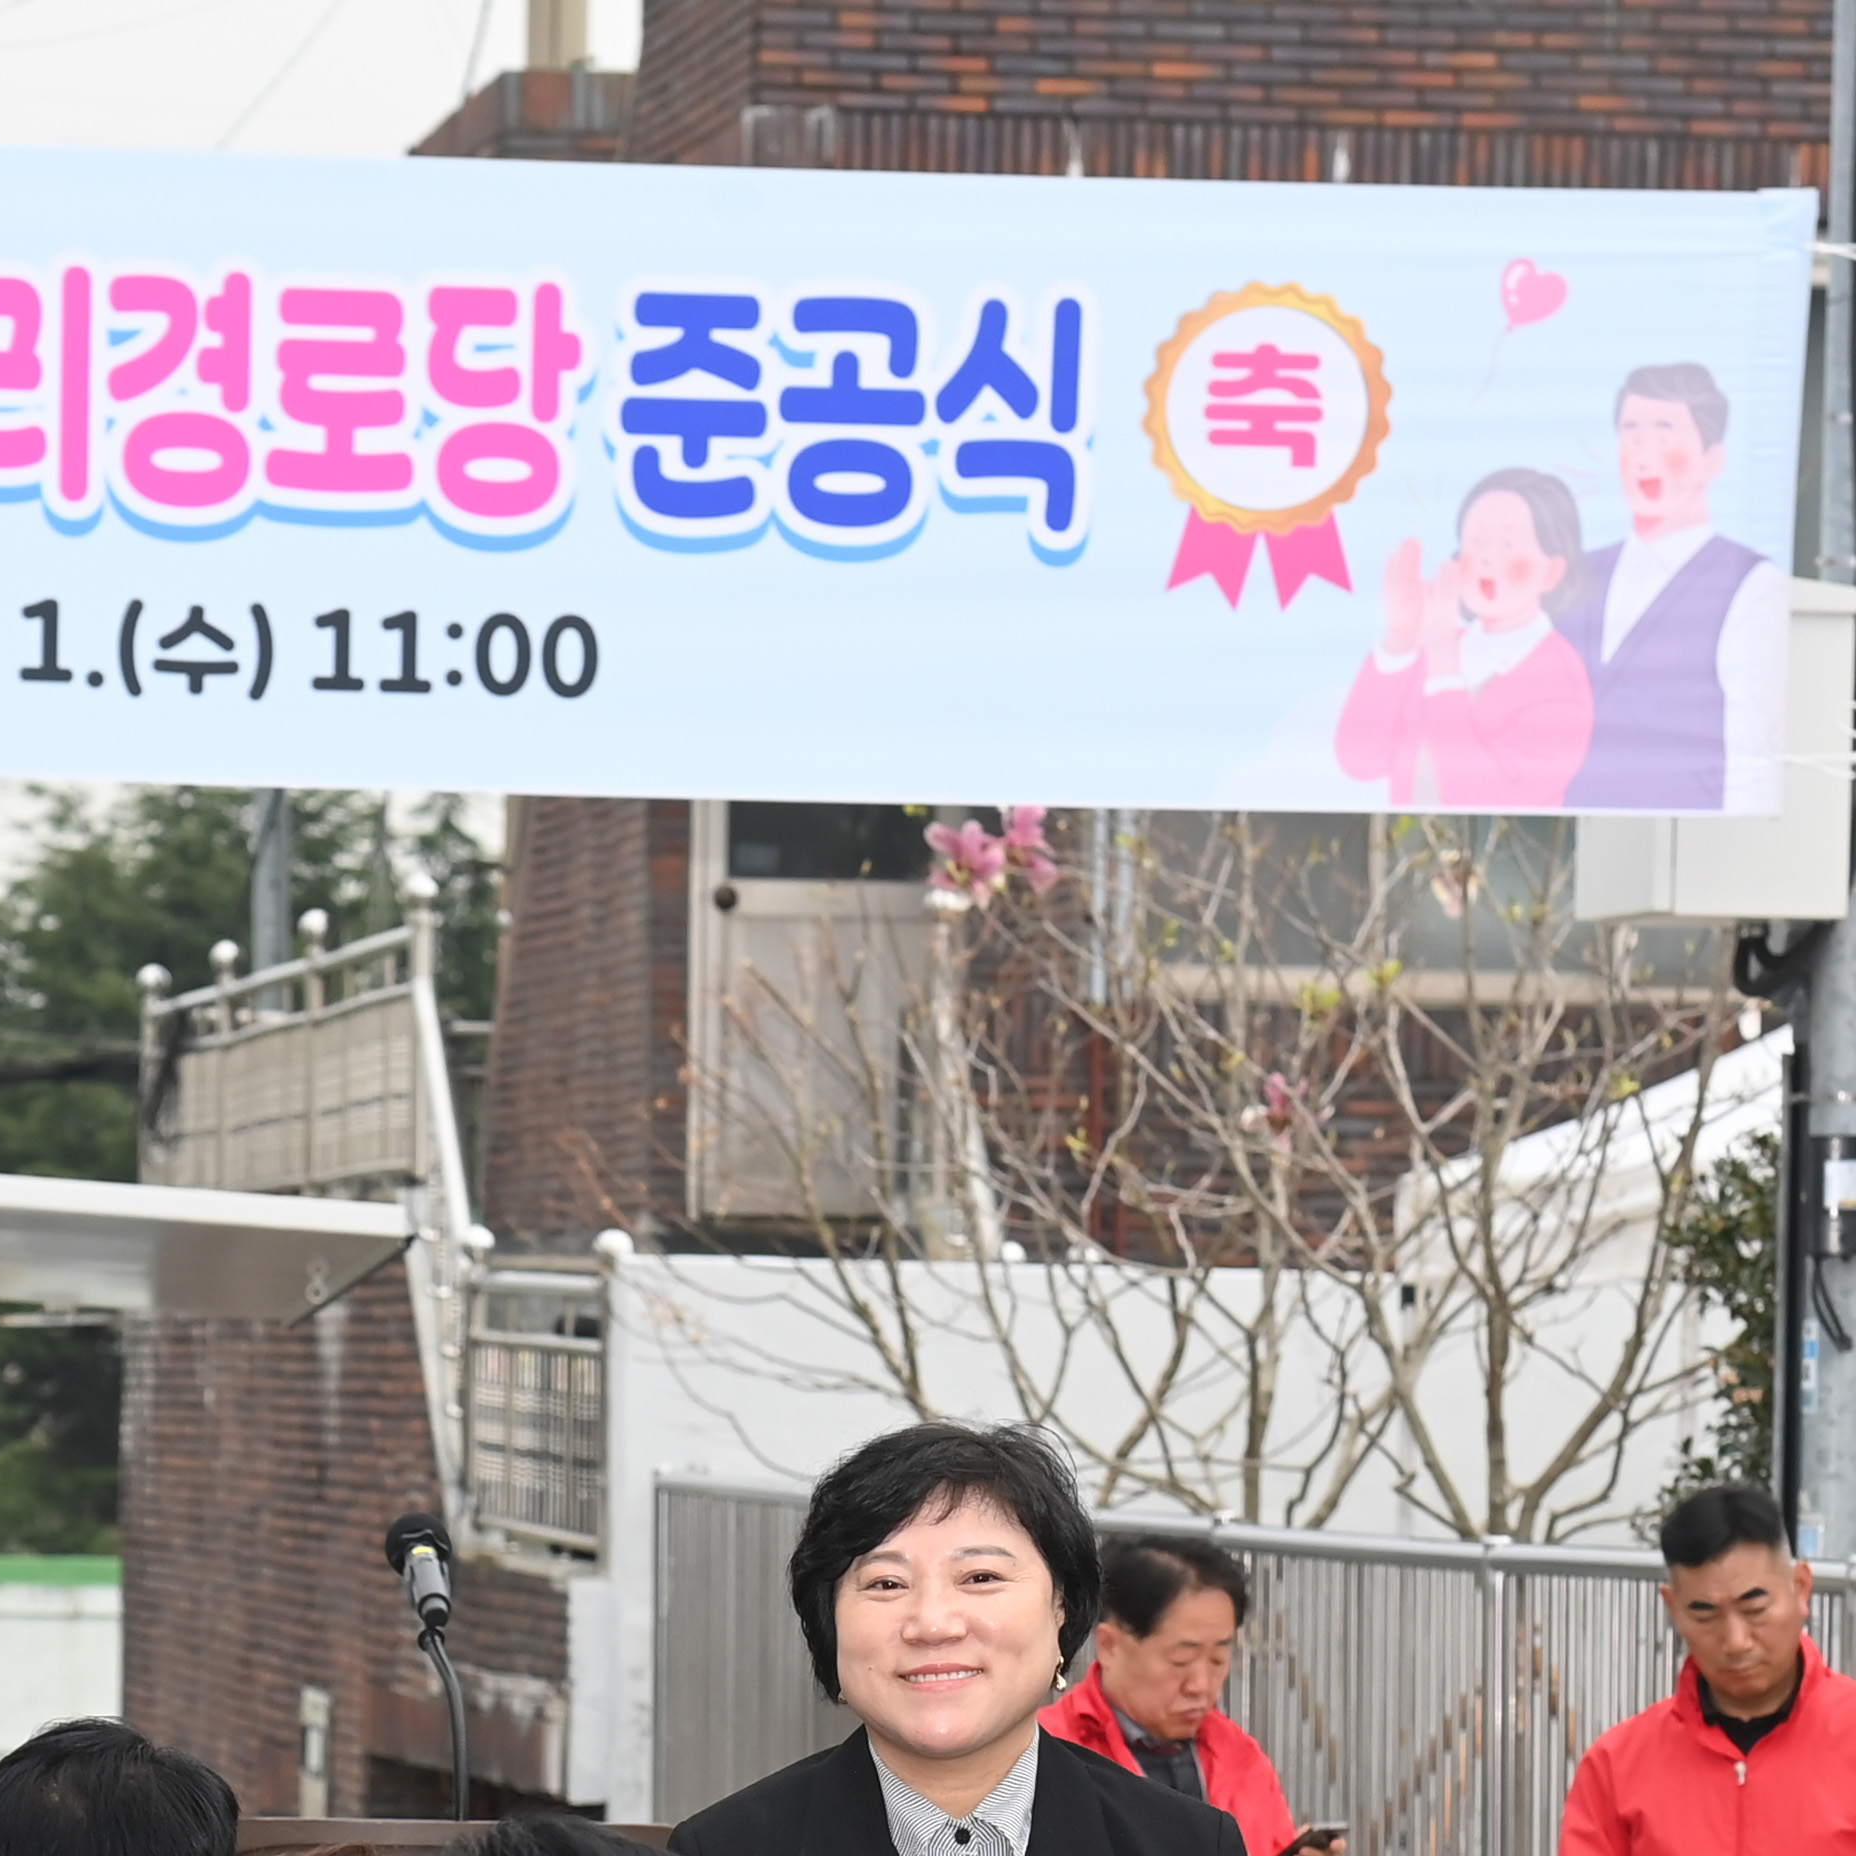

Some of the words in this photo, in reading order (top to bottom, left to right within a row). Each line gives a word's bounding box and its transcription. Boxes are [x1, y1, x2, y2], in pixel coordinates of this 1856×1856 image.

[619, 291, 1083, 534] 준공식
[1204, 342, 1324, 469] 축
[311, 607, 599, 699] 11:00
